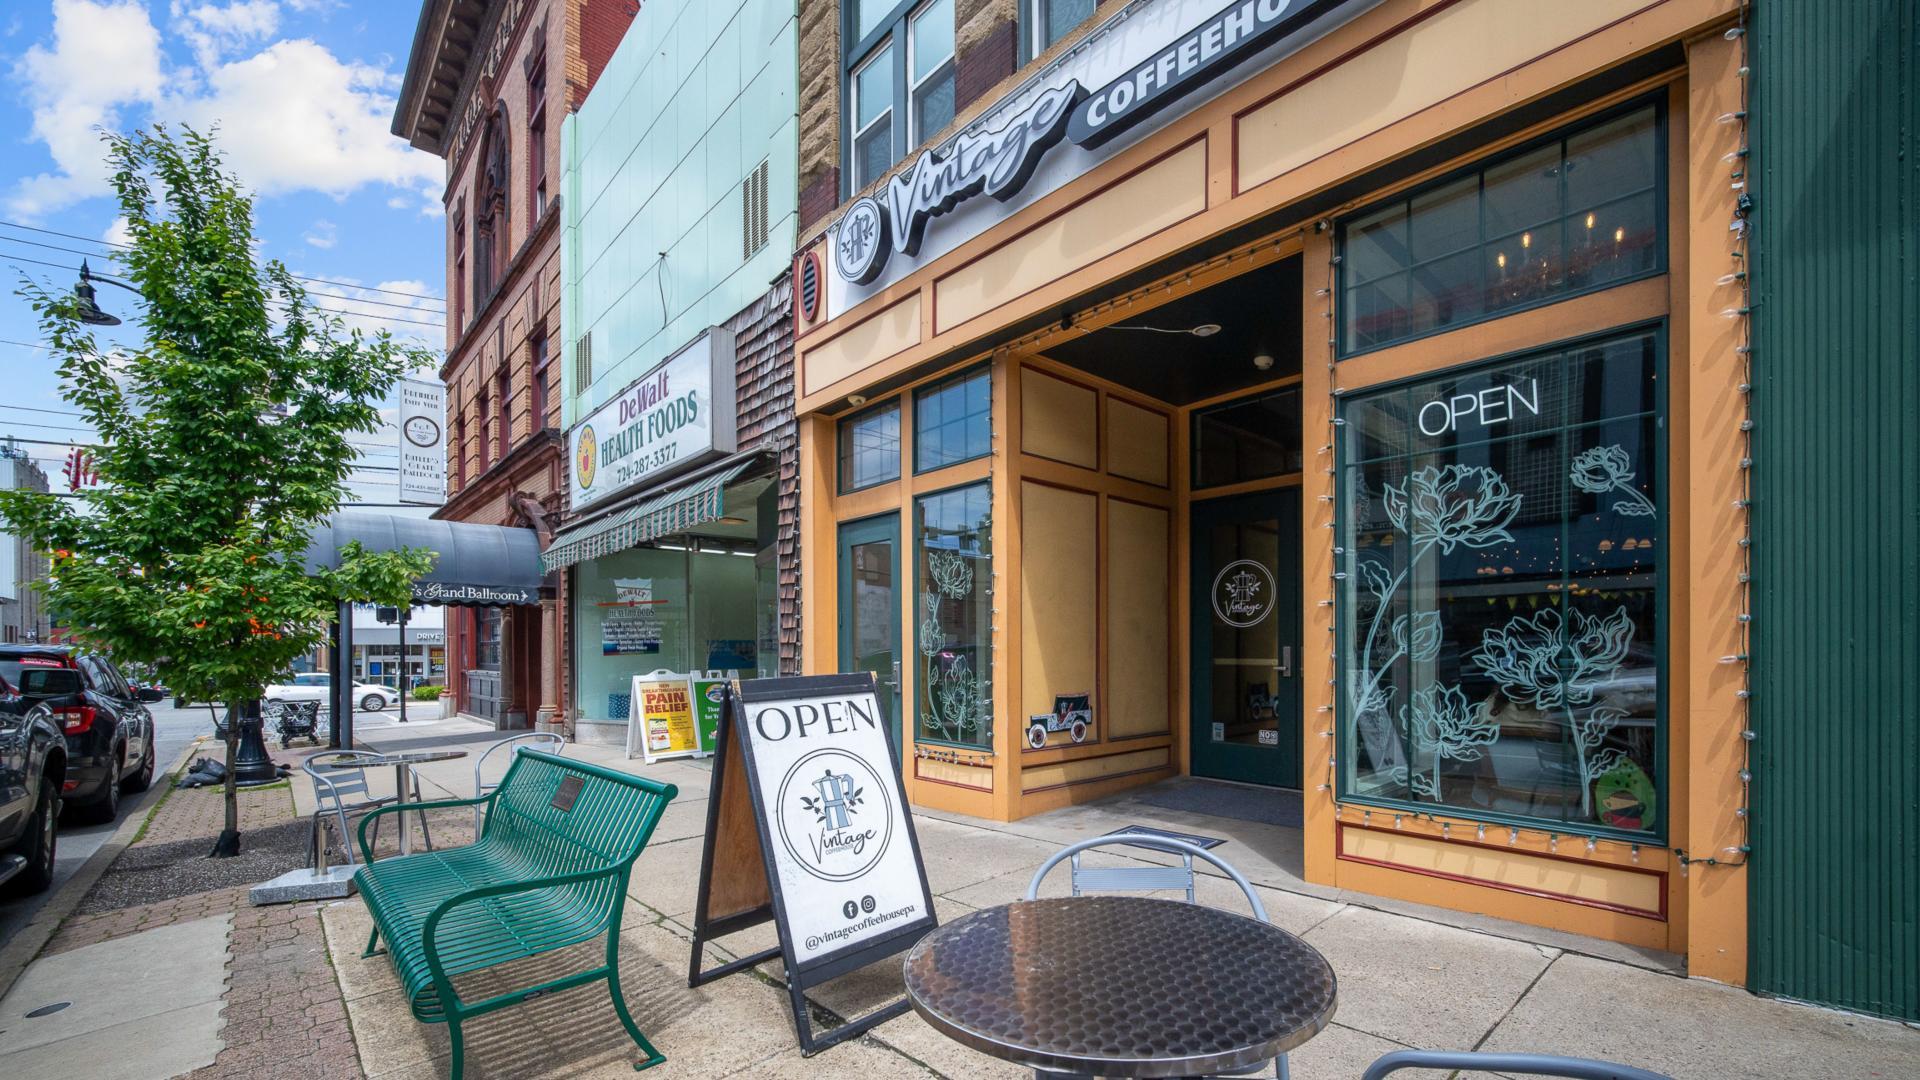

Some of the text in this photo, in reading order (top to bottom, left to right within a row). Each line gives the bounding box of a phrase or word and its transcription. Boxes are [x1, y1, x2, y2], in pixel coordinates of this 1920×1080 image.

[893, 88, 1073, 241] Vintage
[618, 369, 670, 427] DeWalt
[1418, 378, 1539, 436] OPEN
[601, 415, 645, 468] HEALTH
[648, 389, 698, 444] FOODS
[616, 441, 677, 485] 724-287-3377
[423, 582, 465, 599] Grand
[467, 587, 520, 601] Ballroom
[1224, 598, 1264, 617] Vintage
[645, 692, 686, 704] PAIN
[645, 702, 689, 714] RELIEF
[755, 698, 877, 742] OPEN
[808, 827, 877, 865] Vintage
[805, 904, 916, 950] @vintagecoffeehousepa
